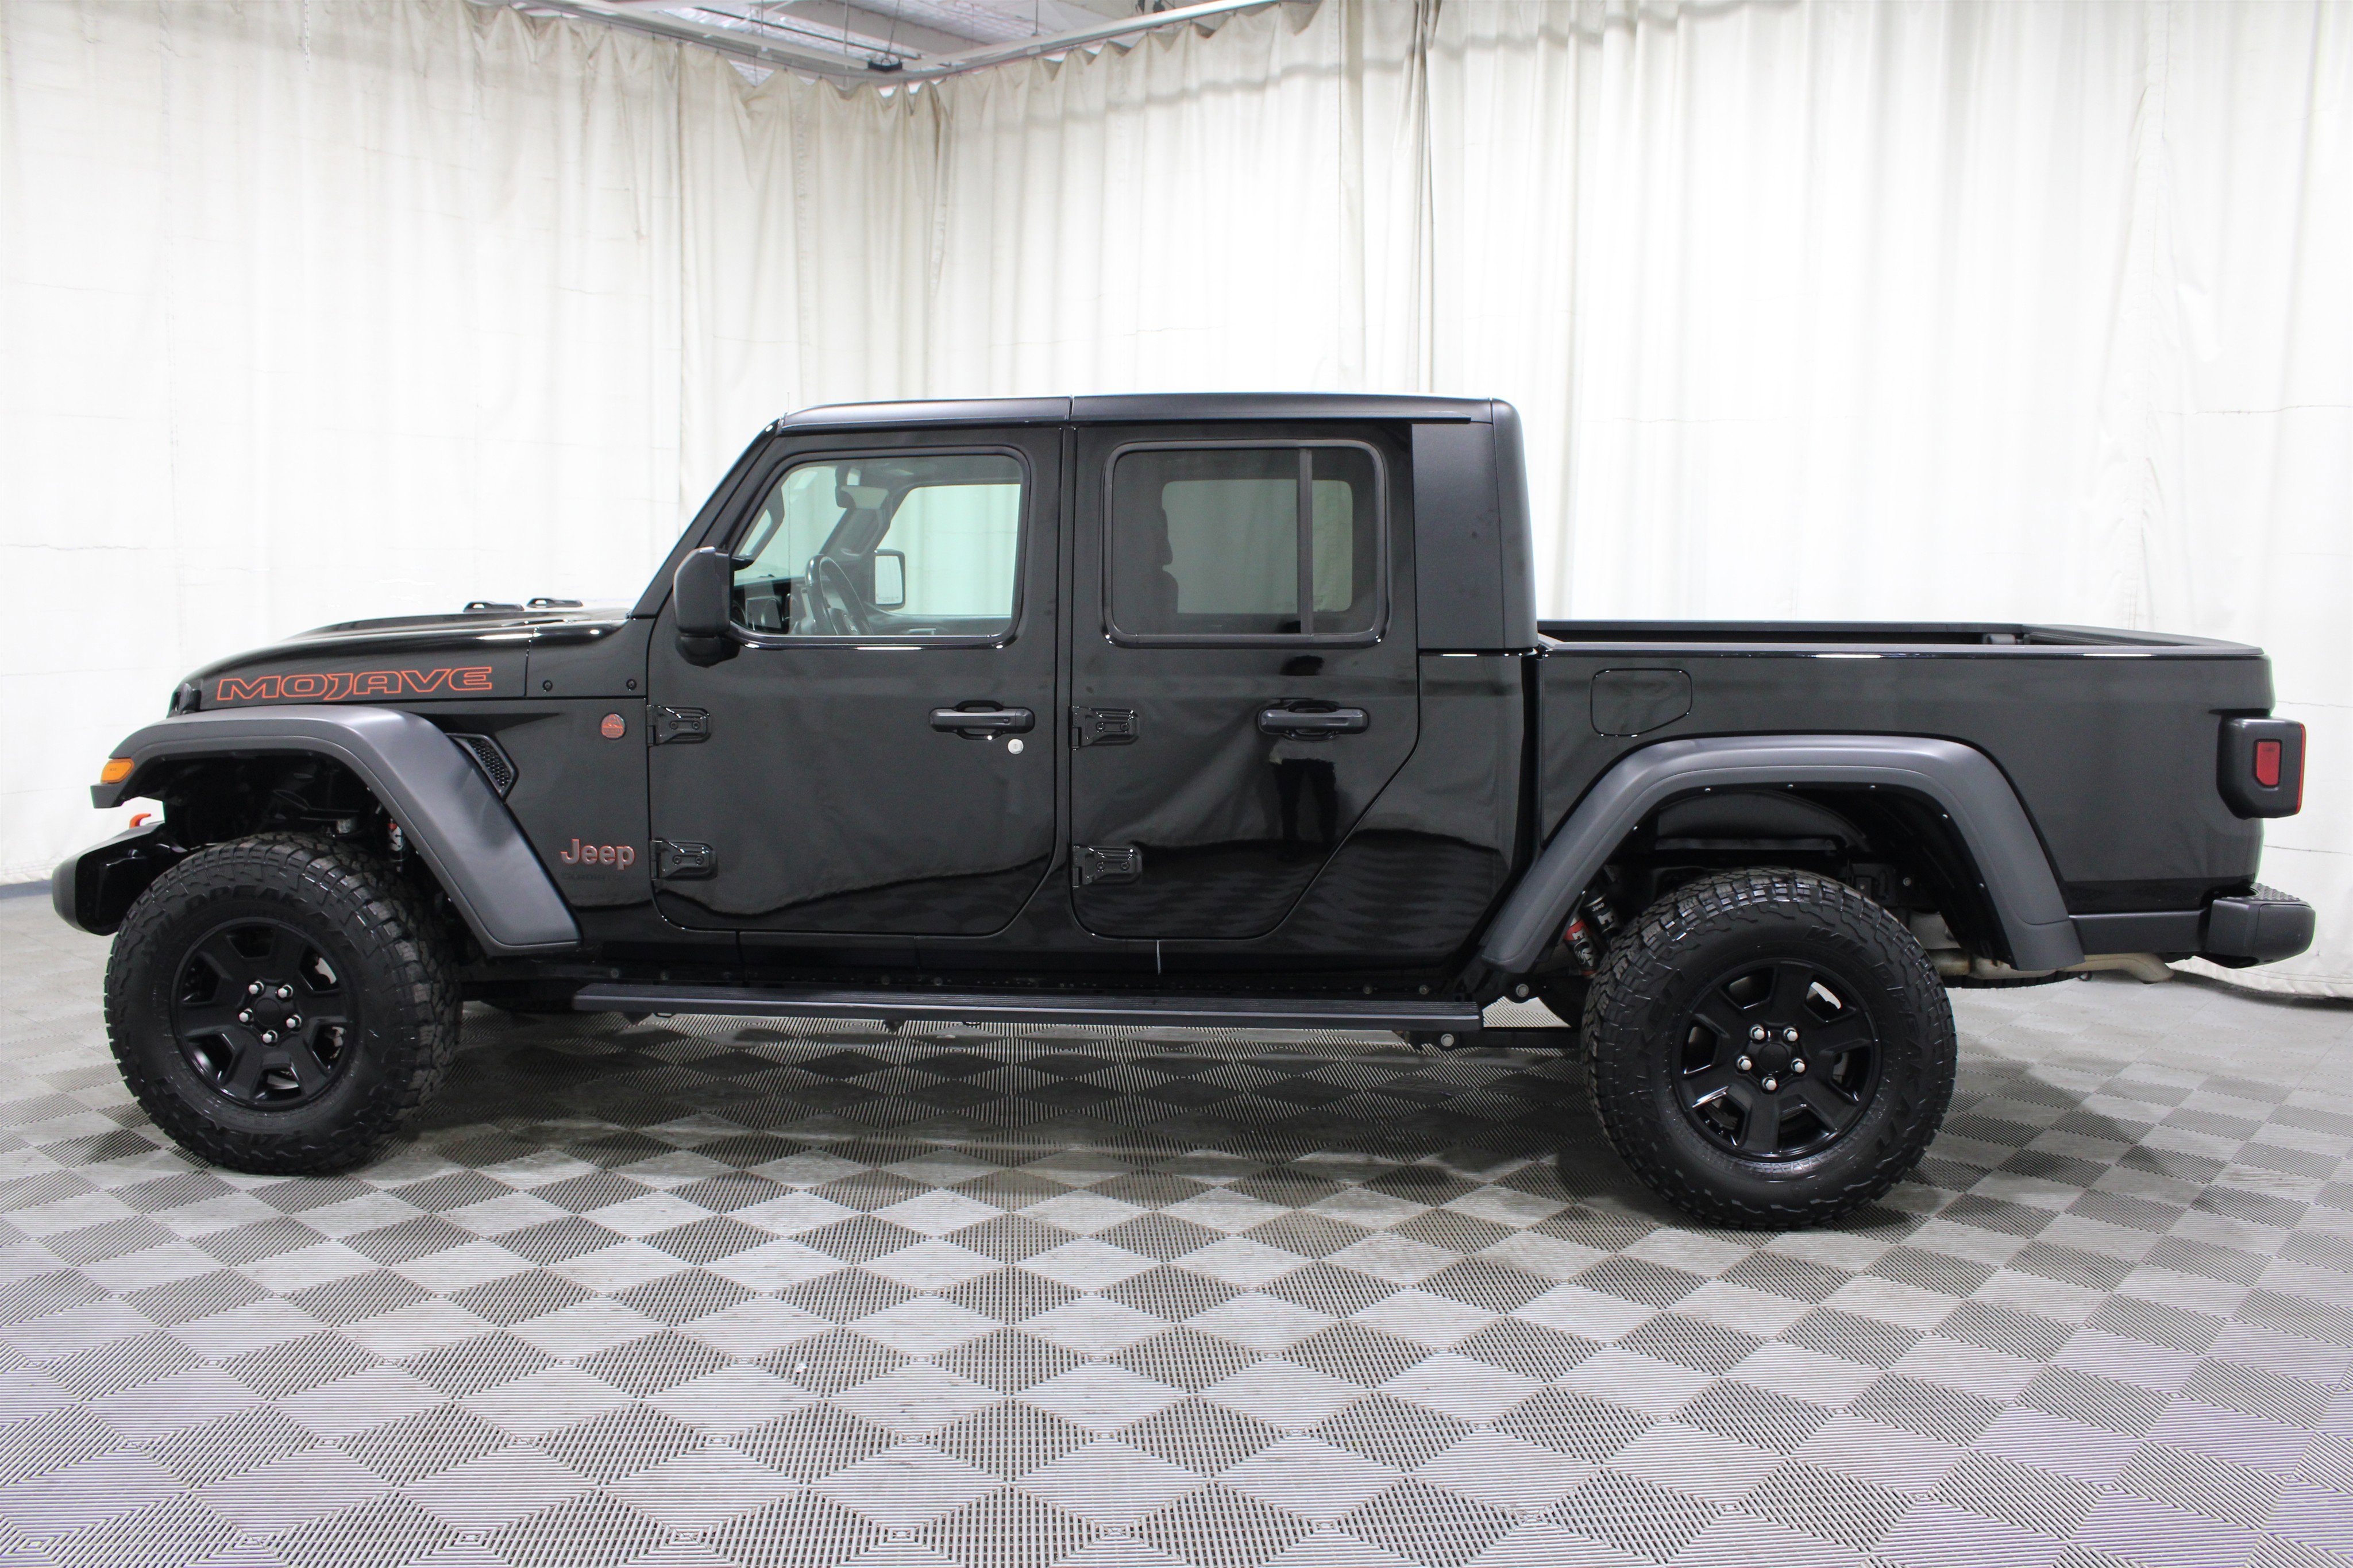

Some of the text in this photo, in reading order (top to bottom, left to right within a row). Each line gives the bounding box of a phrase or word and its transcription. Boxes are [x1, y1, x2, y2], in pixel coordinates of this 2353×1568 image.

[217, 667, 492, 700] MOJAVE
[561, 839, 635, 871] Jeep
[1592, 902, 1604, 912] Jeep
